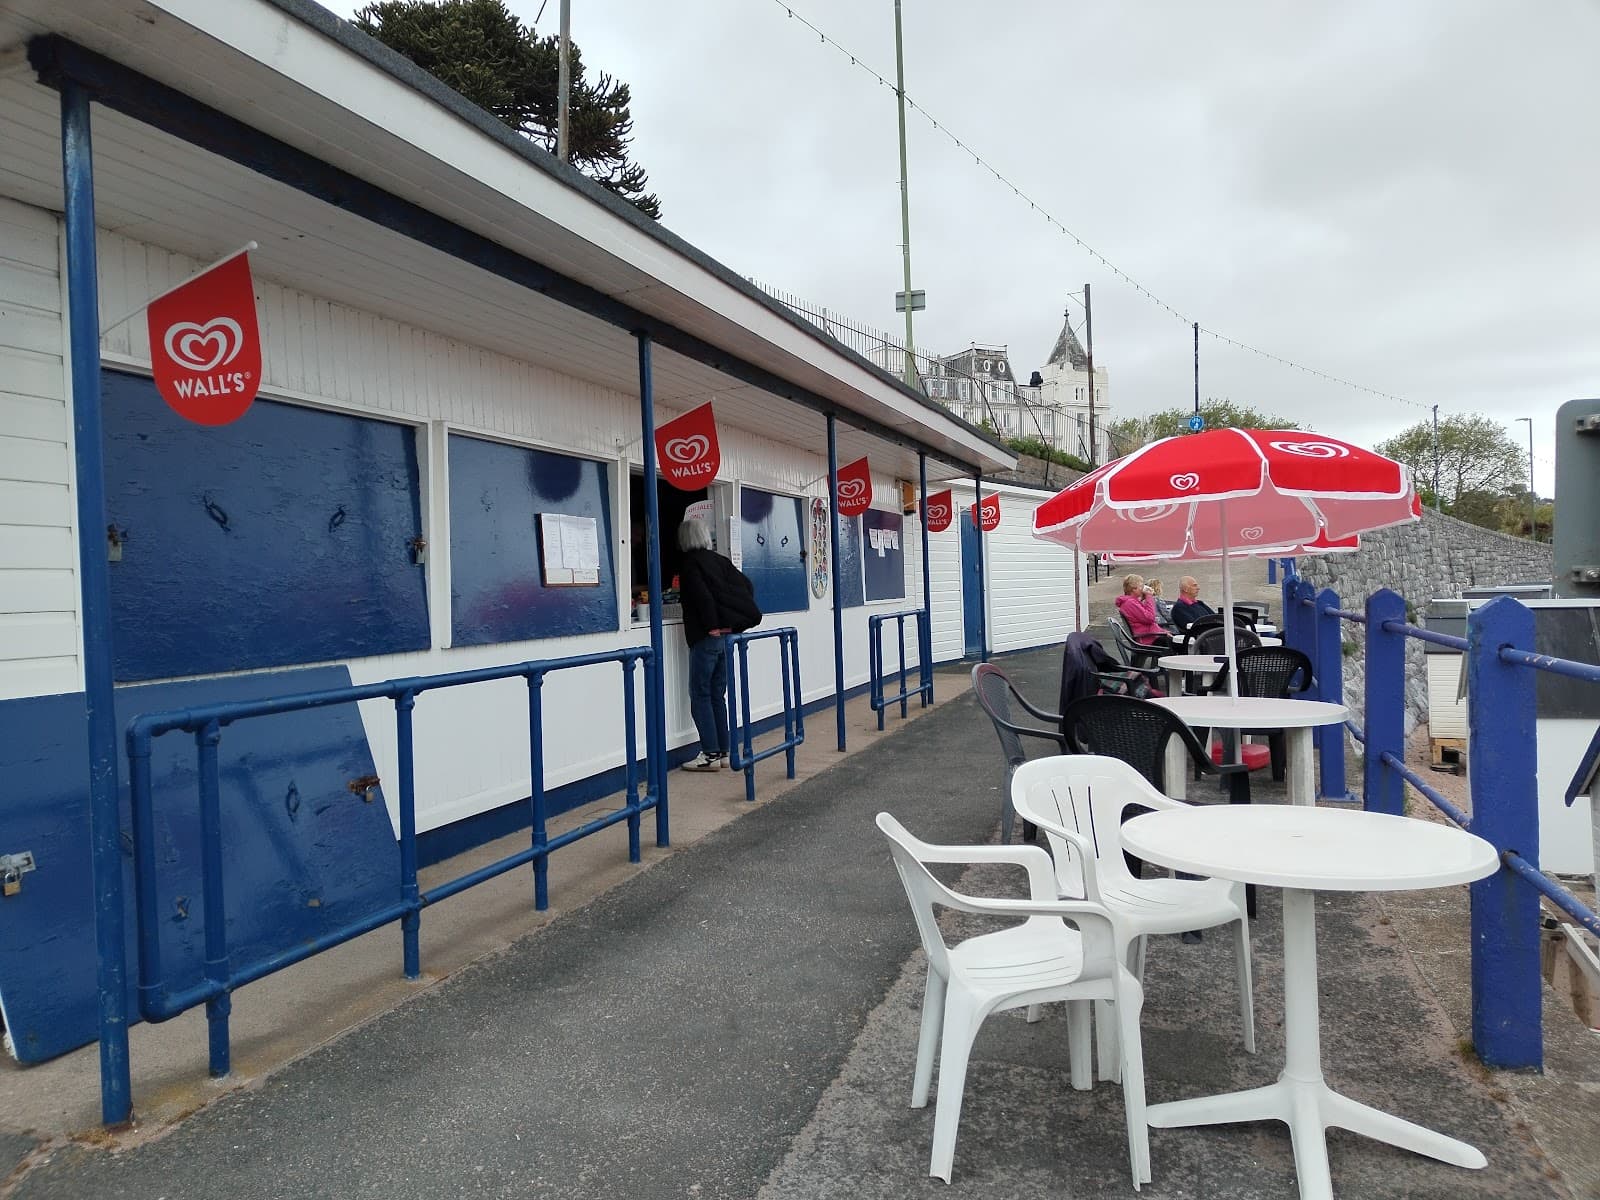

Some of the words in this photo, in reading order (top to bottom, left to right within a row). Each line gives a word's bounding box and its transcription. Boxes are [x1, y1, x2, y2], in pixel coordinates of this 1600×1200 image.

[173, 372, 245, 399] WALL'S
[671, 462, 711, 478] WALL'S
[838, 496, 867, 508] WALL'S
